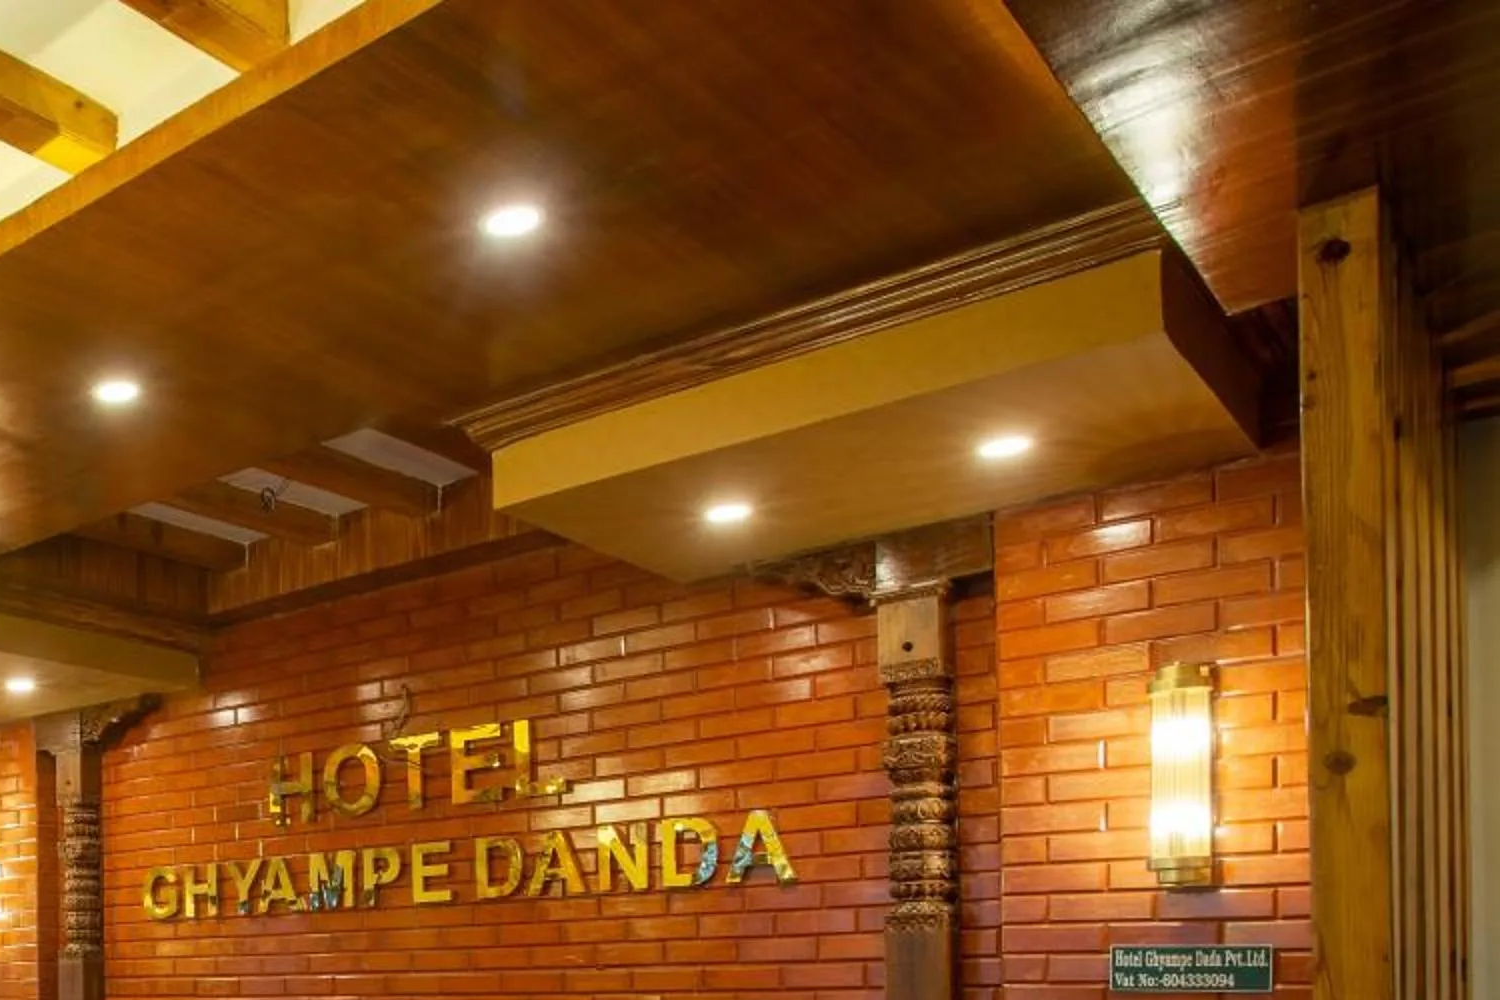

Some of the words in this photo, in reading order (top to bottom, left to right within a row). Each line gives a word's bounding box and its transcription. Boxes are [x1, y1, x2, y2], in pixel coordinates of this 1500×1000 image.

[268, 718, 569, 828] HOTEL
[144, 839, 456, 921] GHYAMPE
[473, 808, 800, 900] DANDA
[1114, 949, 1143, 967] Hotel
[1114, 972, 1135, 988] Vat
